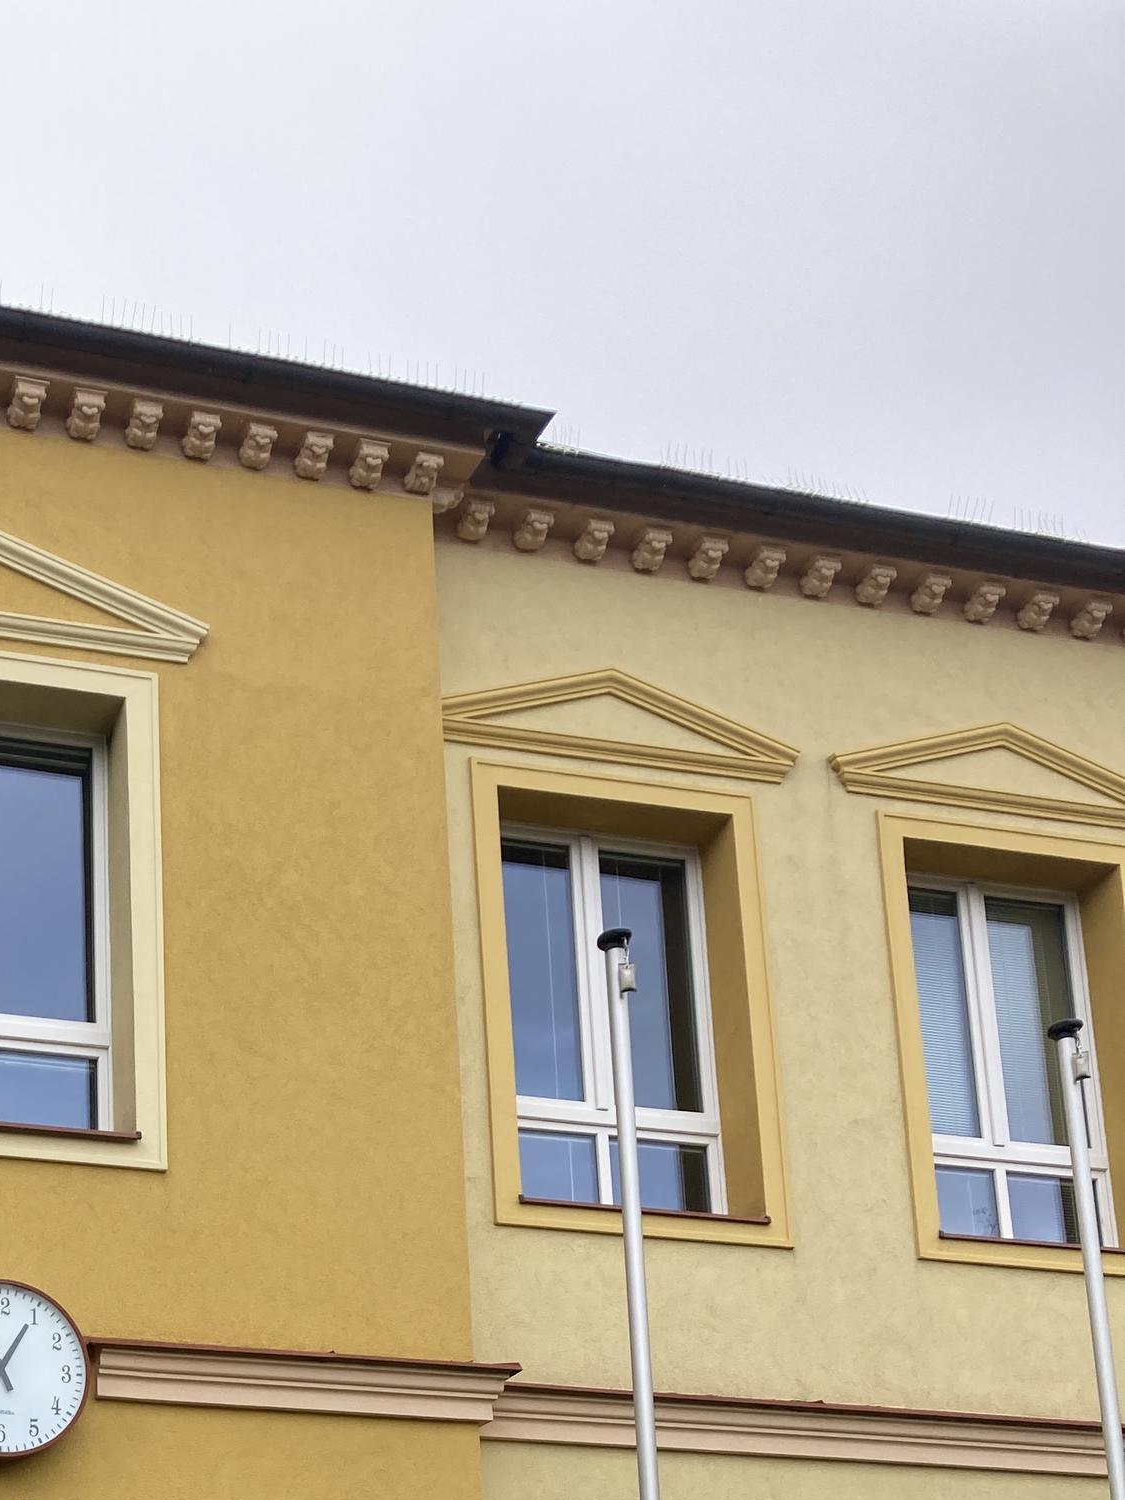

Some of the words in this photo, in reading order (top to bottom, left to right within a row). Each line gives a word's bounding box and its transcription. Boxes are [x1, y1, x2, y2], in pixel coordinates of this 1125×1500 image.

[30, 1308, 39, 1325] 1
[52, 1333, 62, 1351] 2
[61, 1365, 71, 1383] 3
[51, 1396, 61, 1415] 4
[29, 1418, 39, 1437] 5
